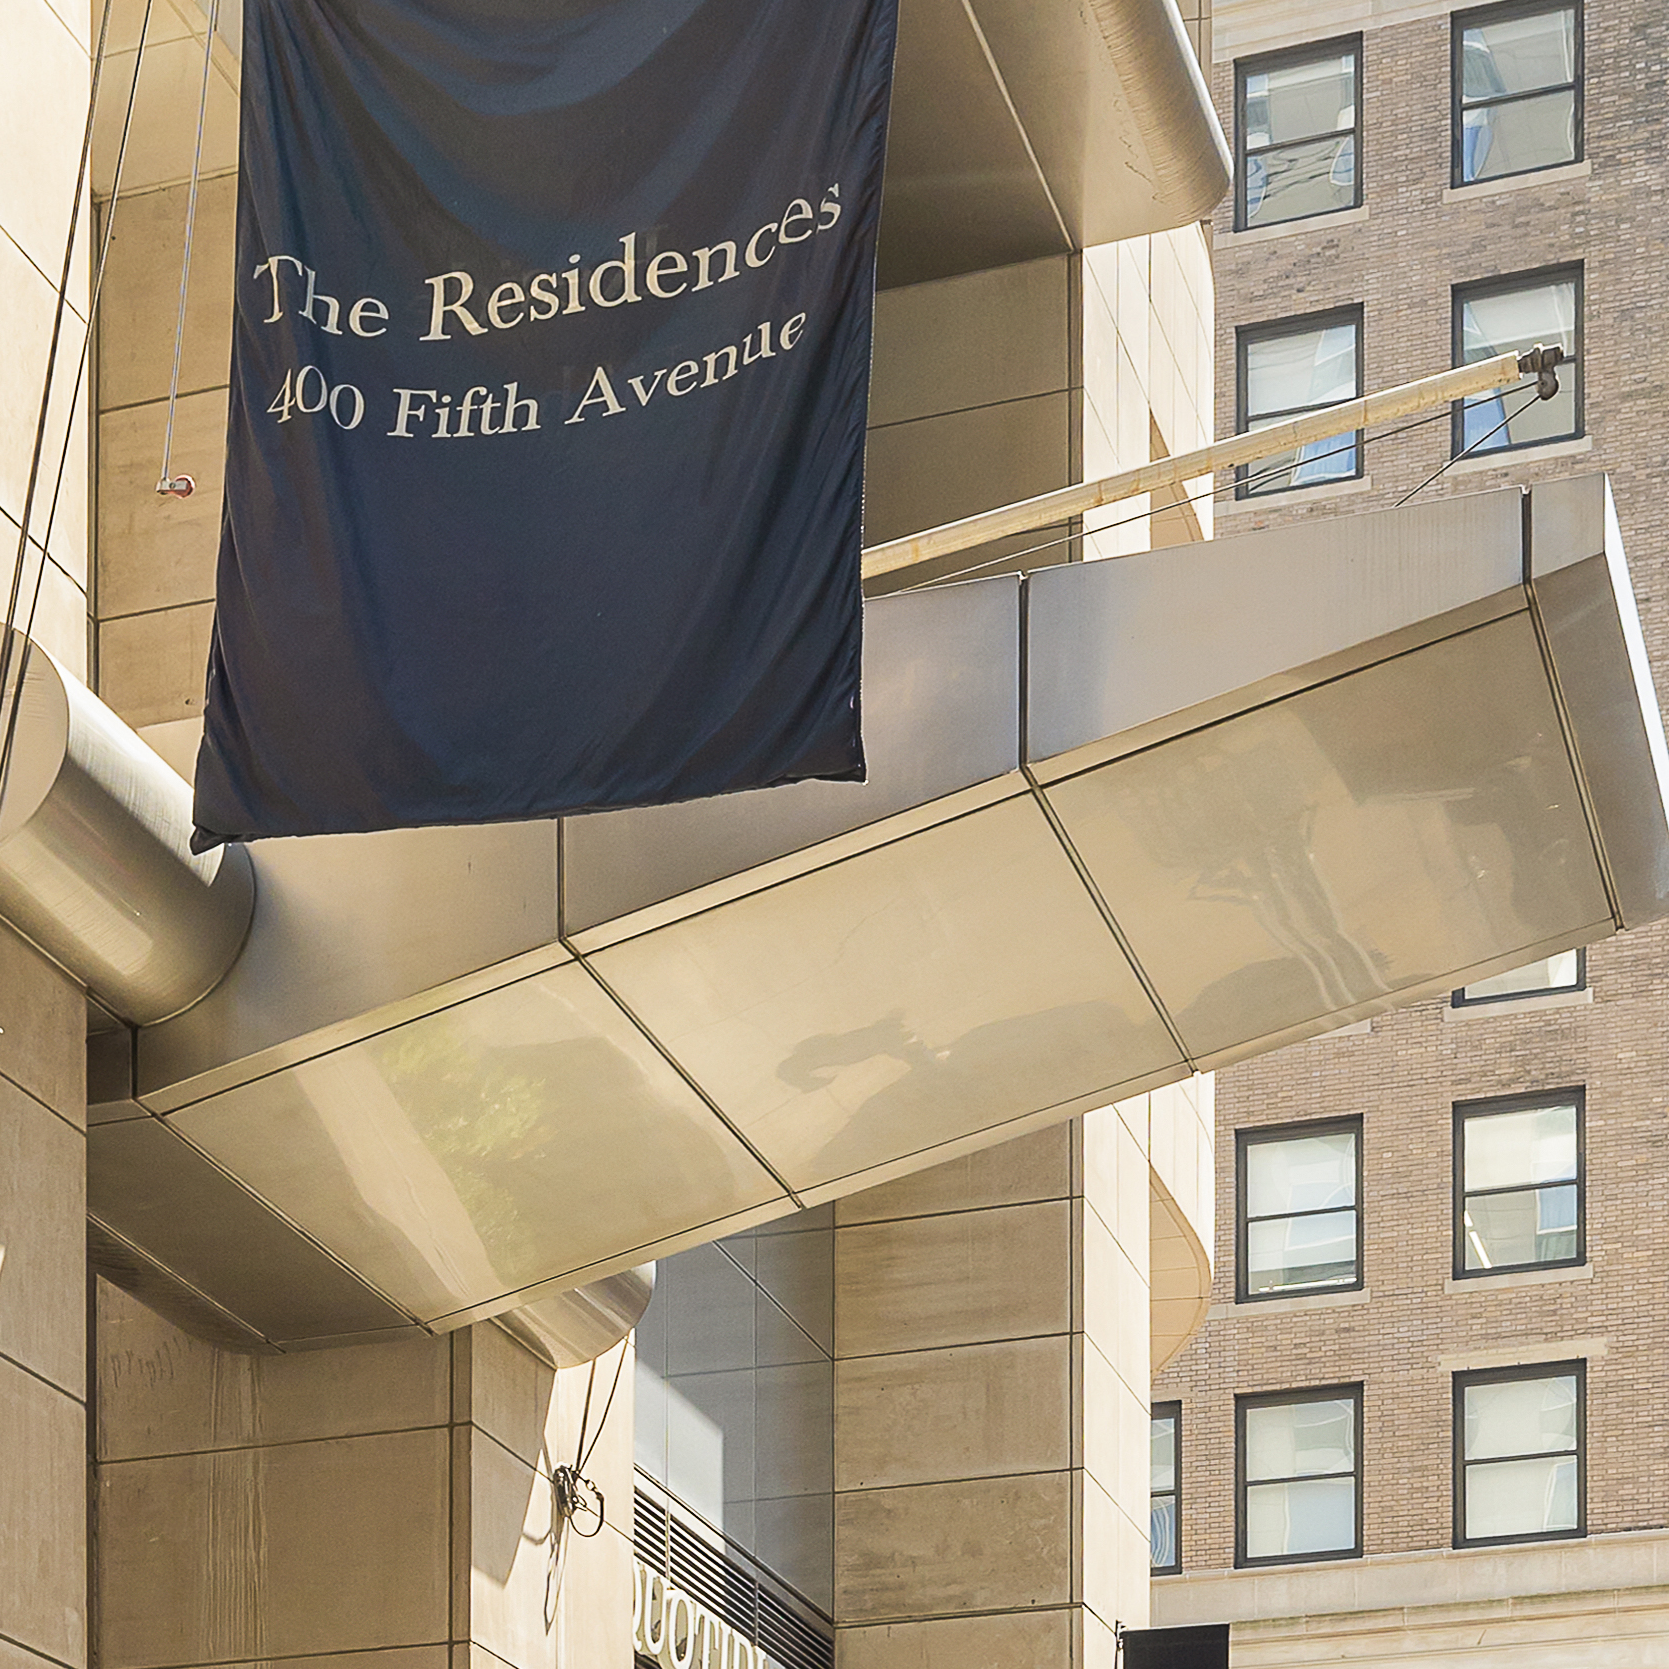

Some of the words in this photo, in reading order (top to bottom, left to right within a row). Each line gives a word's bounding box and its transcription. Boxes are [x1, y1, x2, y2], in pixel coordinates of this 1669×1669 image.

[253, 254, 389, 338] The
[419, 182, 842, 342] Residences
[266, 364, 365, 431] 400
[387, 382, 542, 439] Fifth
[564, 310, 807, 427] Avenue
